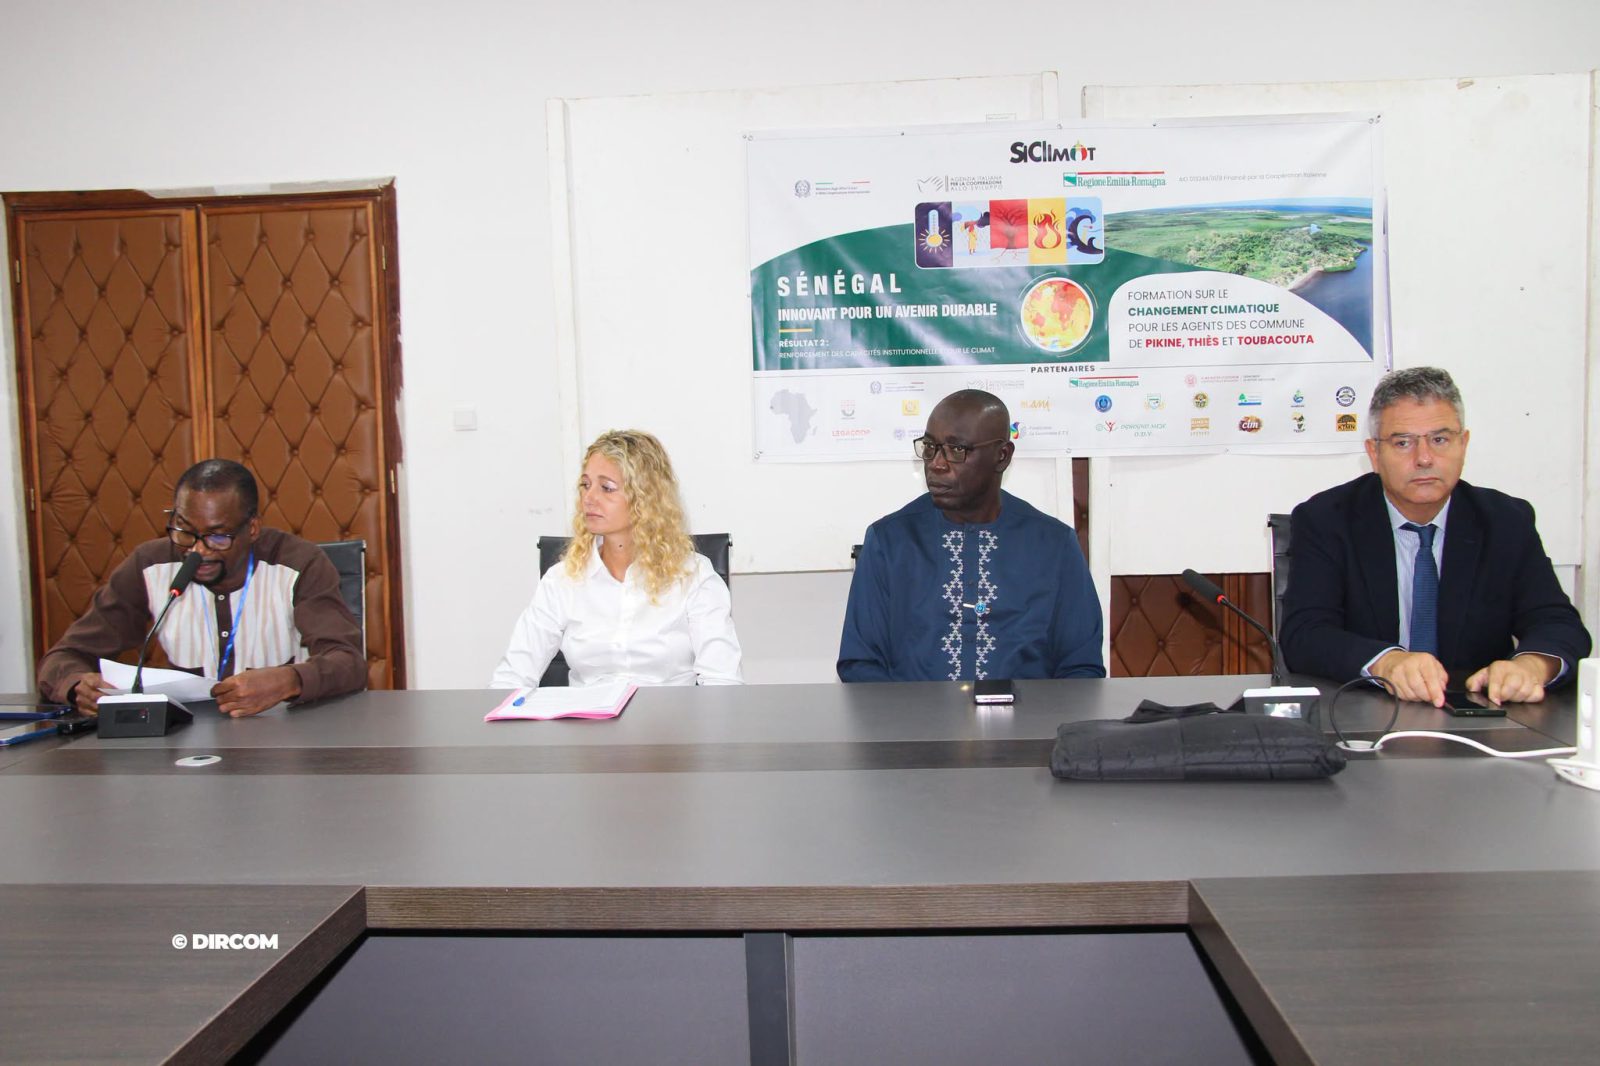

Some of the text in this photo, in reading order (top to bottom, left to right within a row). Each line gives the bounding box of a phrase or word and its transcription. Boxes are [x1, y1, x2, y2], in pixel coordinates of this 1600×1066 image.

[1078, 176, 1107, 188] Regione
[777, 270, 902, 297] SÉNÉGAL
[1128, 288, 1229, 301] FORMATION SUR LE
[778, 303, 998, 322] INNOVANT POUR UN AVENIR DURABLE
[1128, 303, 1280, 317] CHANGEMENT CLIMATIQUE
[1129, 318, 1305, 333] POUR LES AGENTS DES COMMUNE
[779, 338, 819, 348] RÉSULTAT
[1129, 334, 1315, 349] DE PIKINE, THIÈS ET TOUBACOUTA
[779, 351, 830, 359] RENFORCEMENT
[970, 346, 995, 354] CLIMAT
[1030, 365, 1096, 373] PARTENAIRES
[1242, 420, 1259, 429] cim
